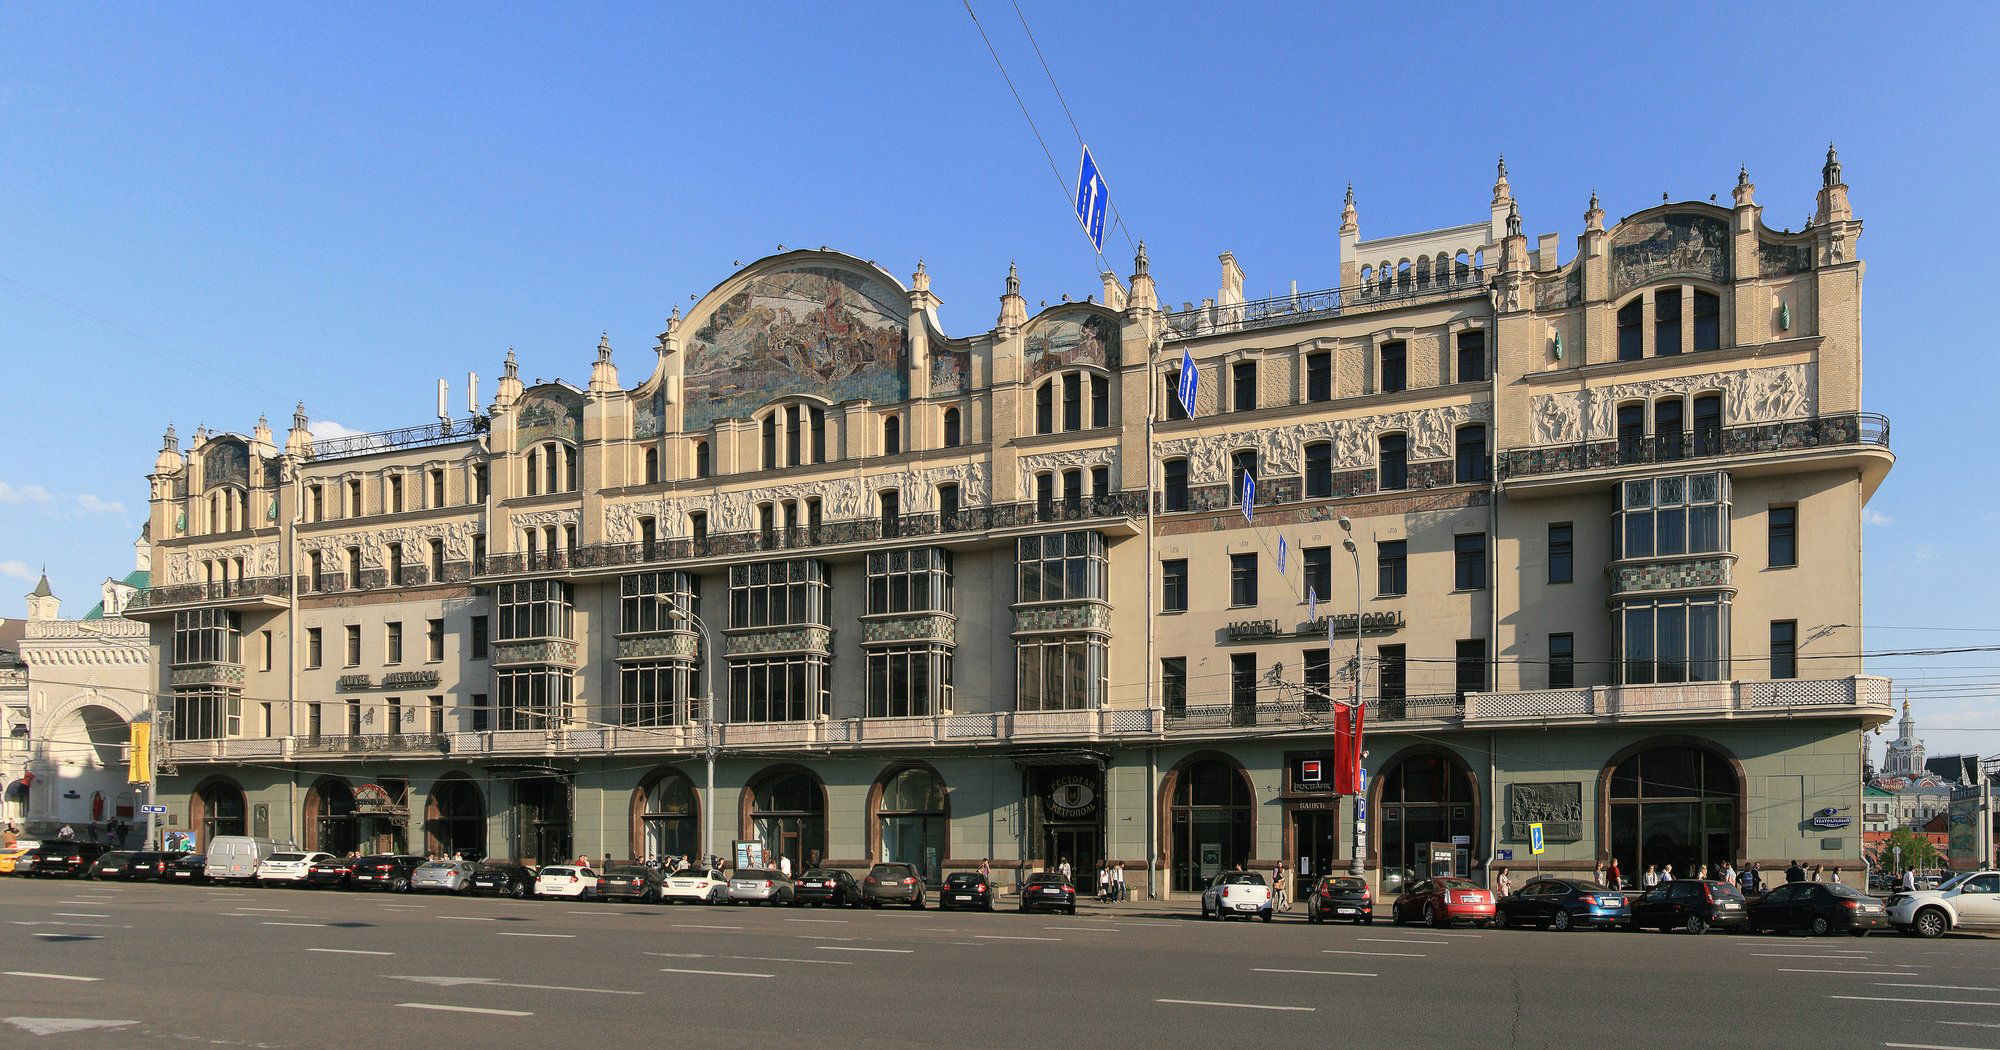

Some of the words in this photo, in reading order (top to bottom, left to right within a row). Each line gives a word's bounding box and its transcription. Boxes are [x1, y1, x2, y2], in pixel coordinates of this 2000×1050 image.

[1227, 619, 1282, 636] HOTEL
[1051, 776, 1095, 790] РЕСТОРАН
[1294, 781, 1331, 792] РОСБАНК
[1052, 803, 1096, 816] МЕТРОПОЛЬ
